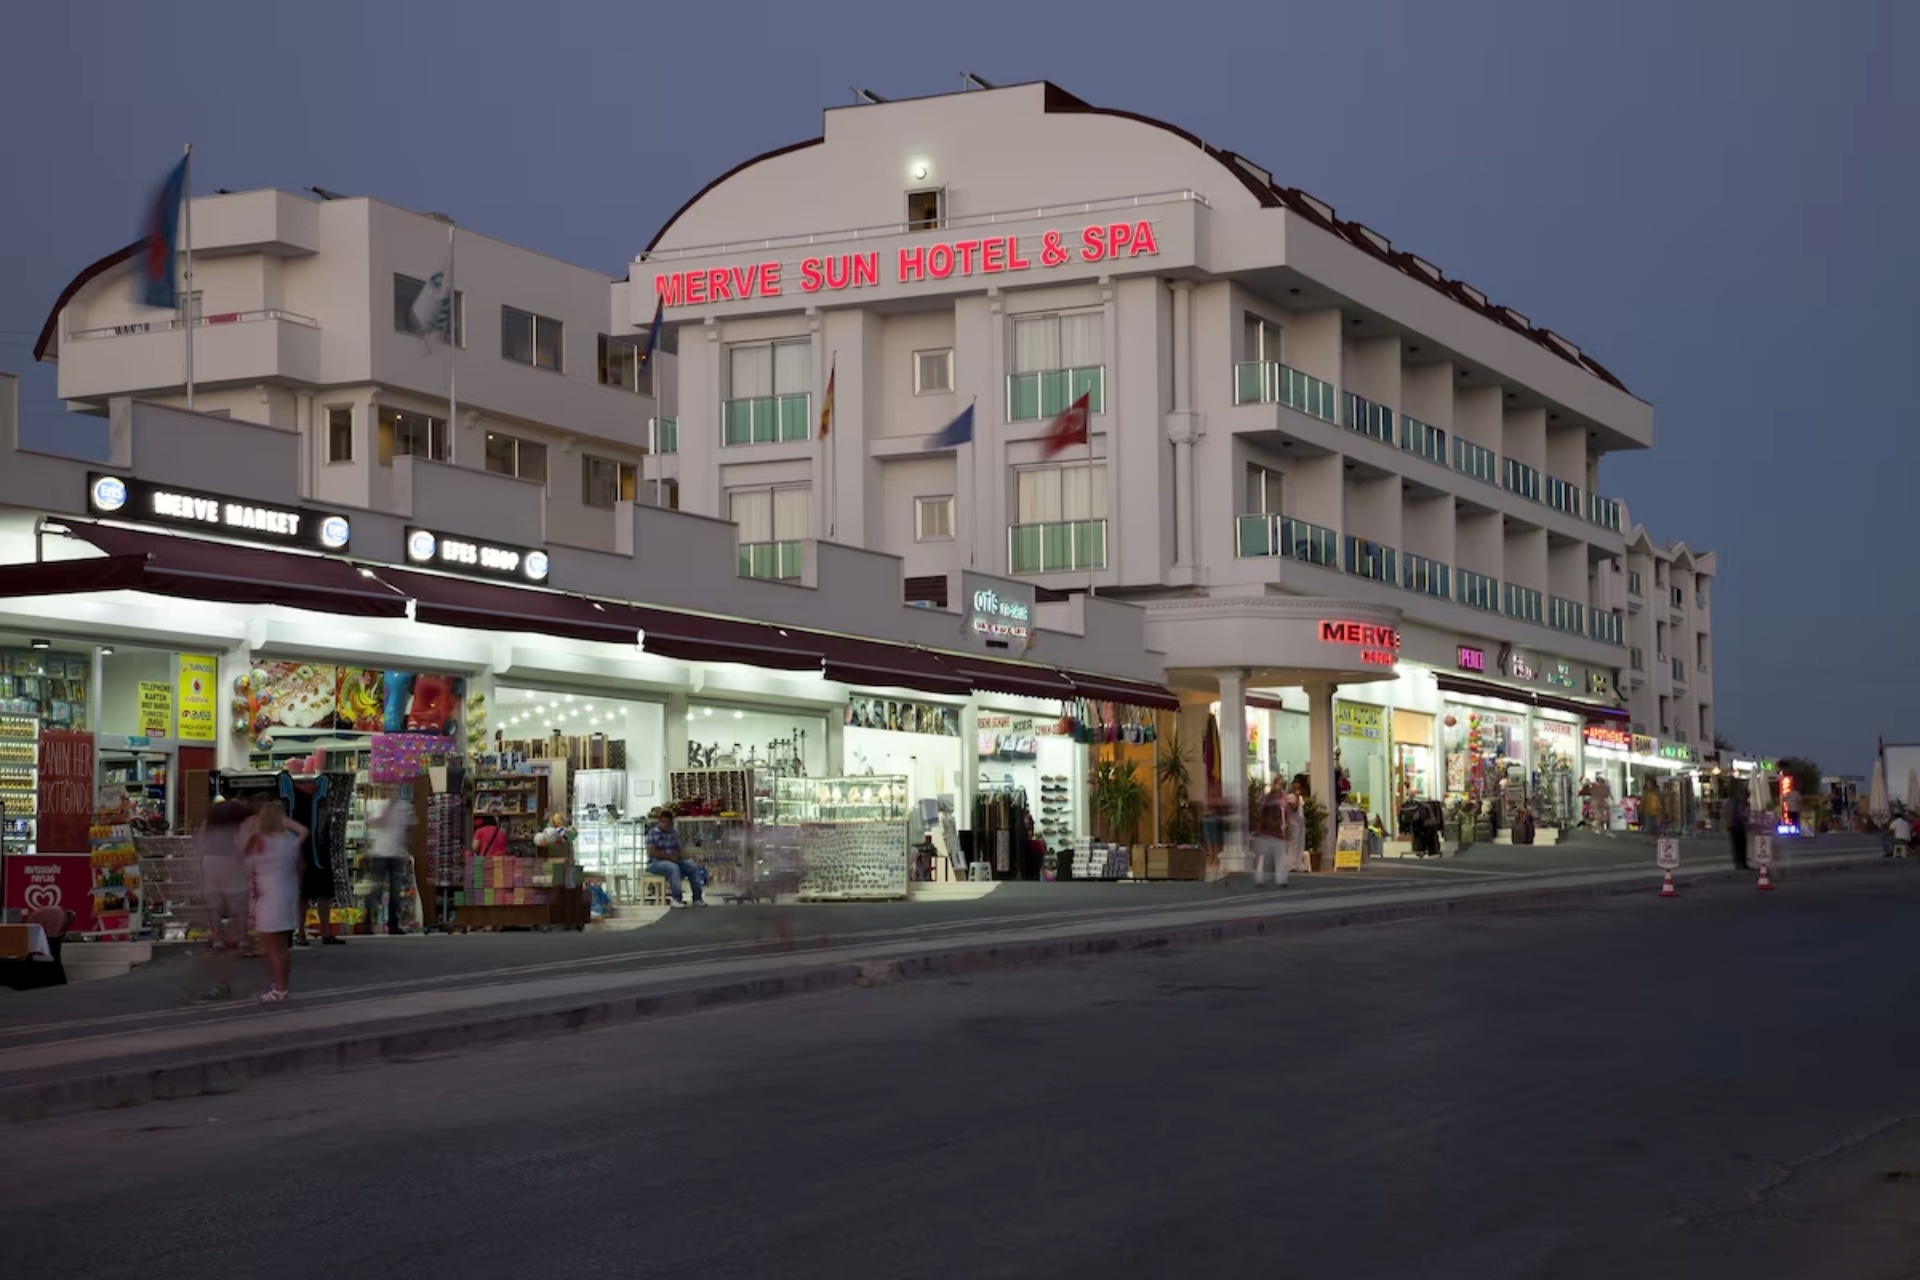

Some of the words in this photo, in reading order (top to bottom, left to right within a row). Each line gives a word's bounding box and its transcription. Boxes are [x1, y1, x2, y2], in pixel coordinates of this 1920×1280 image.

[655, 262, 781, 306] MERVE
[800, 251, 878, 293] SUN
[898, 235, 1029, 282] HOTEL
[1040, 229, 1070, 267] &
[1081, 219, 1158, 262] SPA
[153, 491, 219, 523] MERVE
[225, 503, 300, 536] MARKET
[442, 540, 478, 565] EFES
[1318, 619, 1400, 651] MERVE
